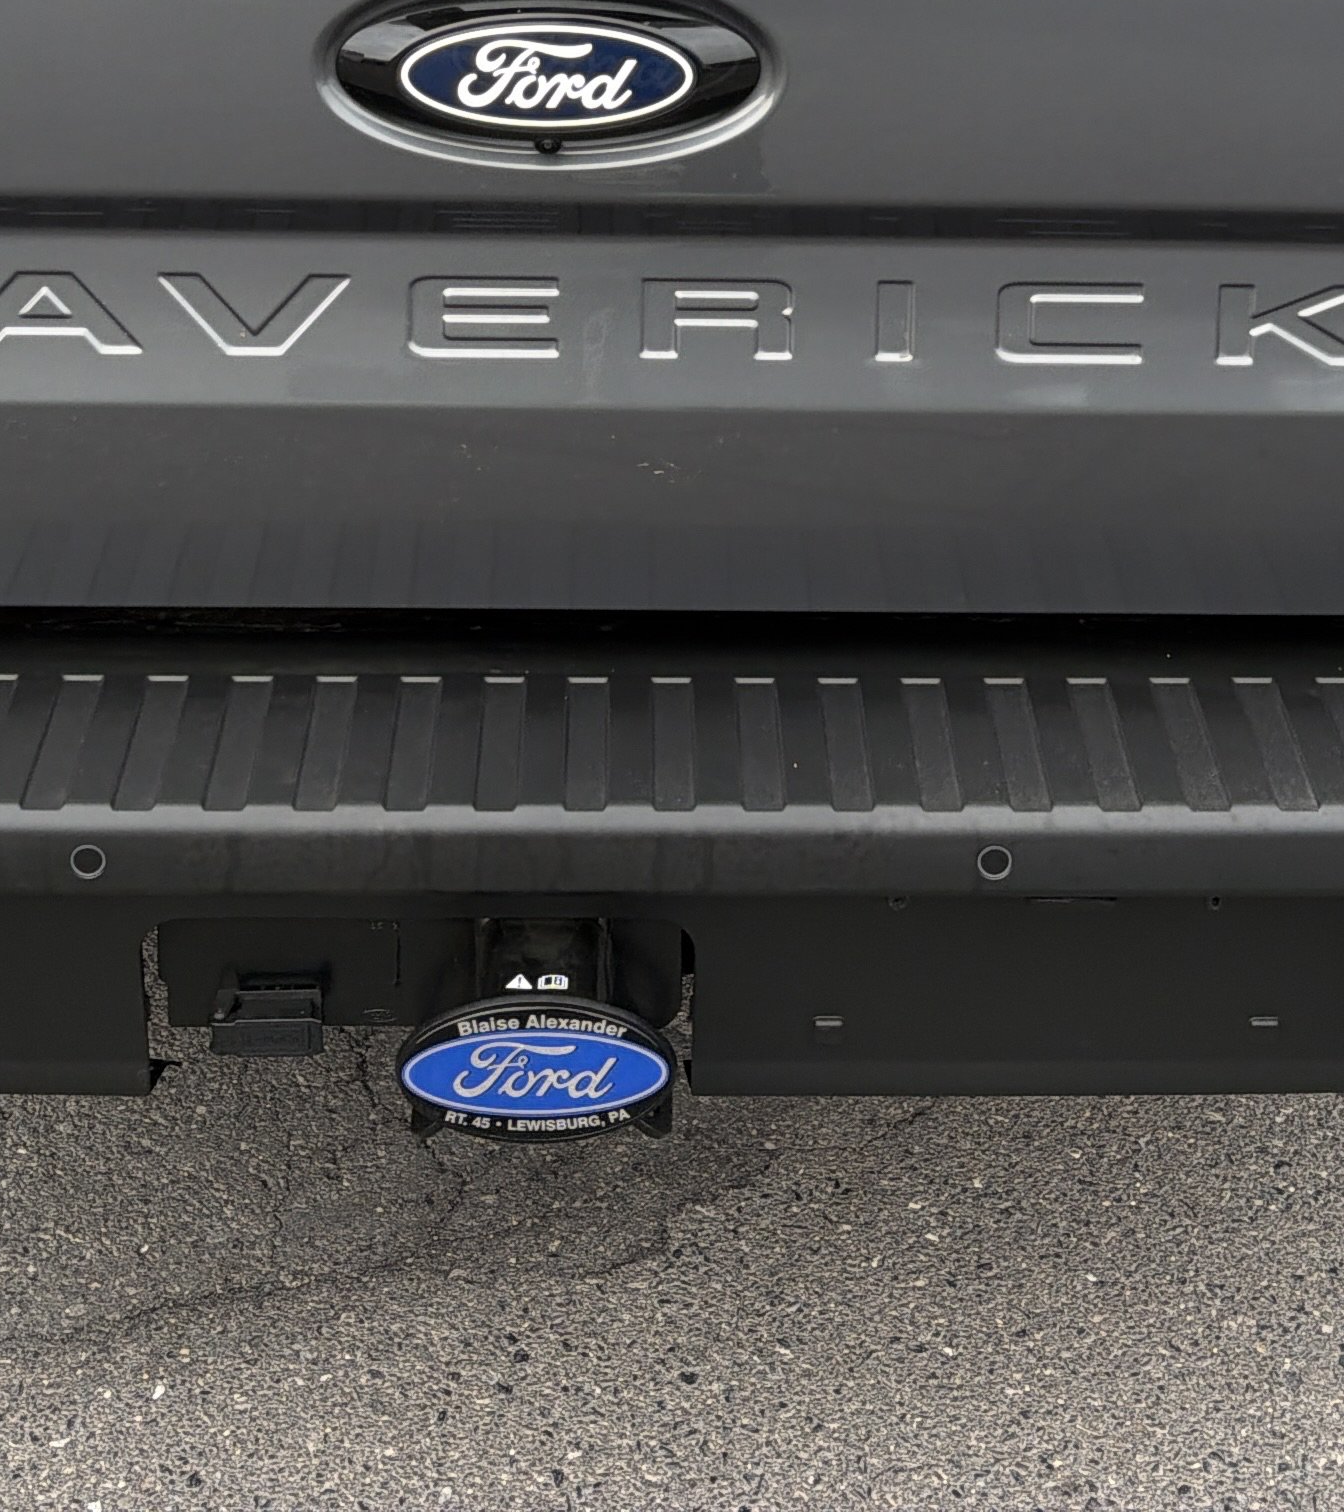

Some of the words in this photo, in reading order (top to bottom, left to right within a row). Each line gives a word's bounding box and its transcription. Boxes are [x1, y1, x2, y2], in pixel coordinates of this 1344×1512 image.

[457, 39, 638, 110] Ford
[457, 1016, 521, 1038] Blaise
[525, 1014, 627, 1038] Alexander
[453, 1042, 617, 1098] Ford
[444, 1109, 470, 1127] RT.
[471, 1116, 491, 1129] 45
[507, 1116, 606, 1132] LEWISBURG,
[609, 1109, 631, 1124] PA
